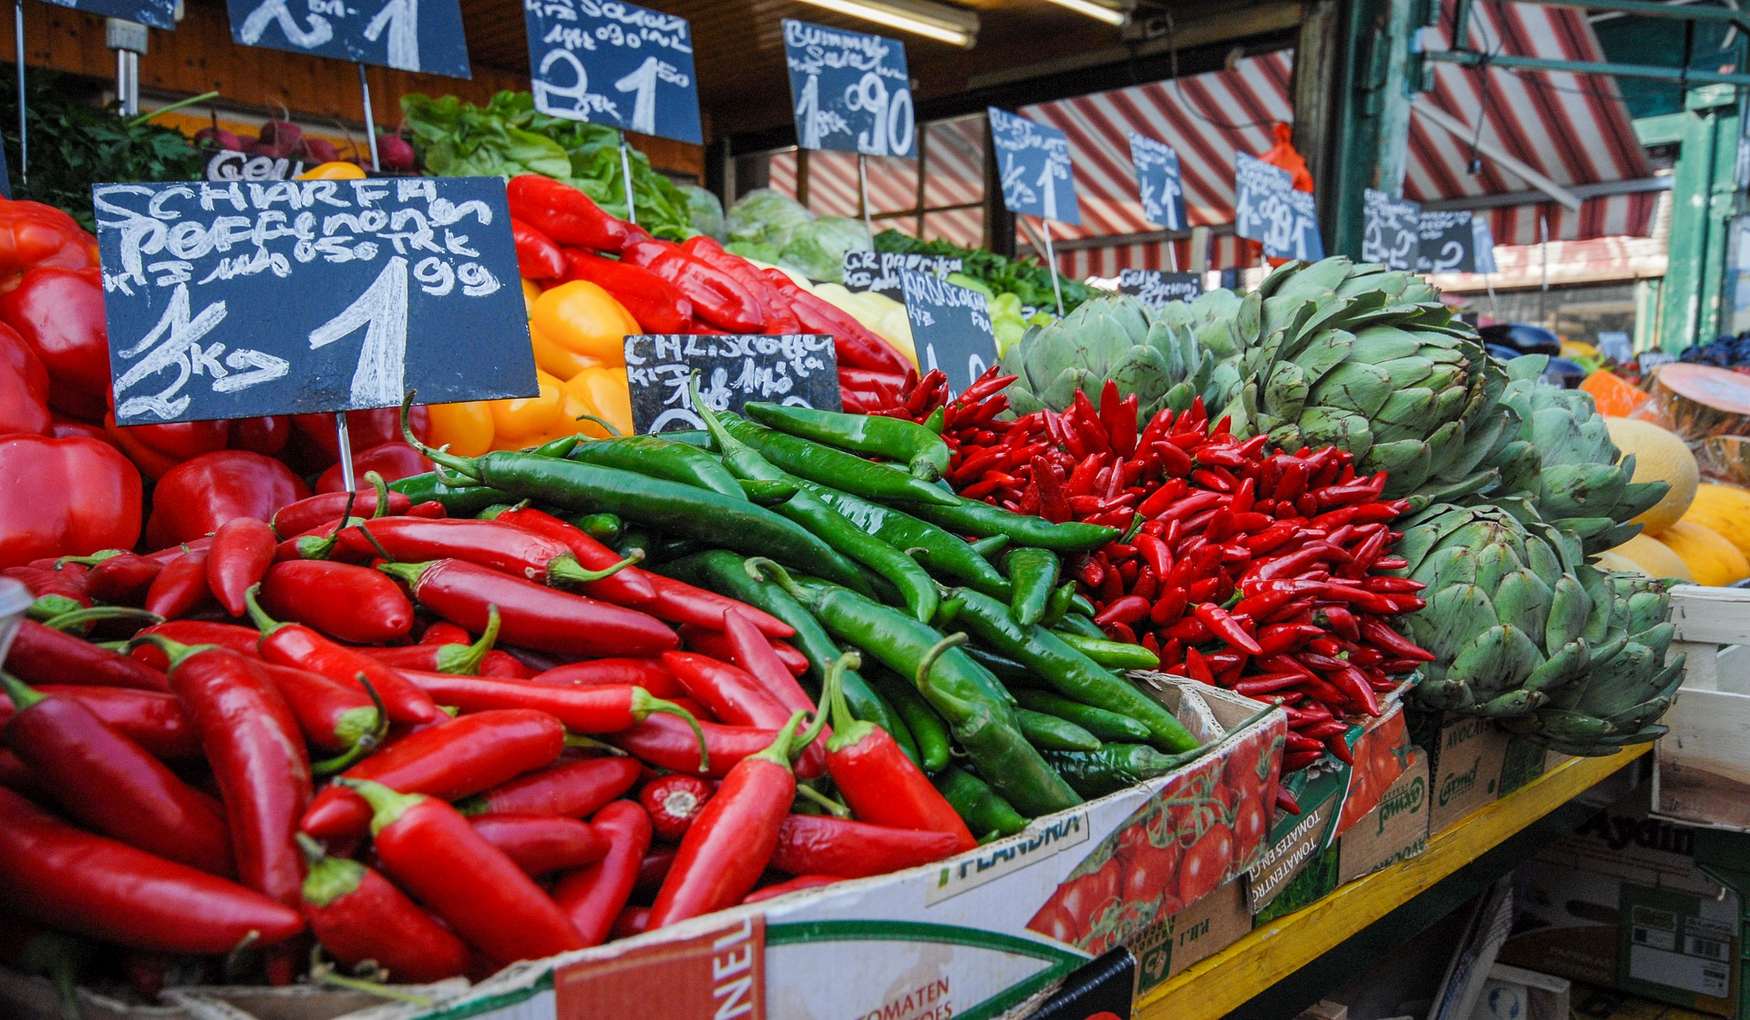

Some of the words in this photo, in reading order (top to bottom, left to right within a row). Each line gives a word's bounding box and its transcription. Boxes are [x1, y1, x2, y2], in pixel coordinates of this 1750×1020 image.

[614, 56, 657, 136] 1
[303, 255, 408, 403] 1
[1275, 810, 1321, 857] TOMATES
